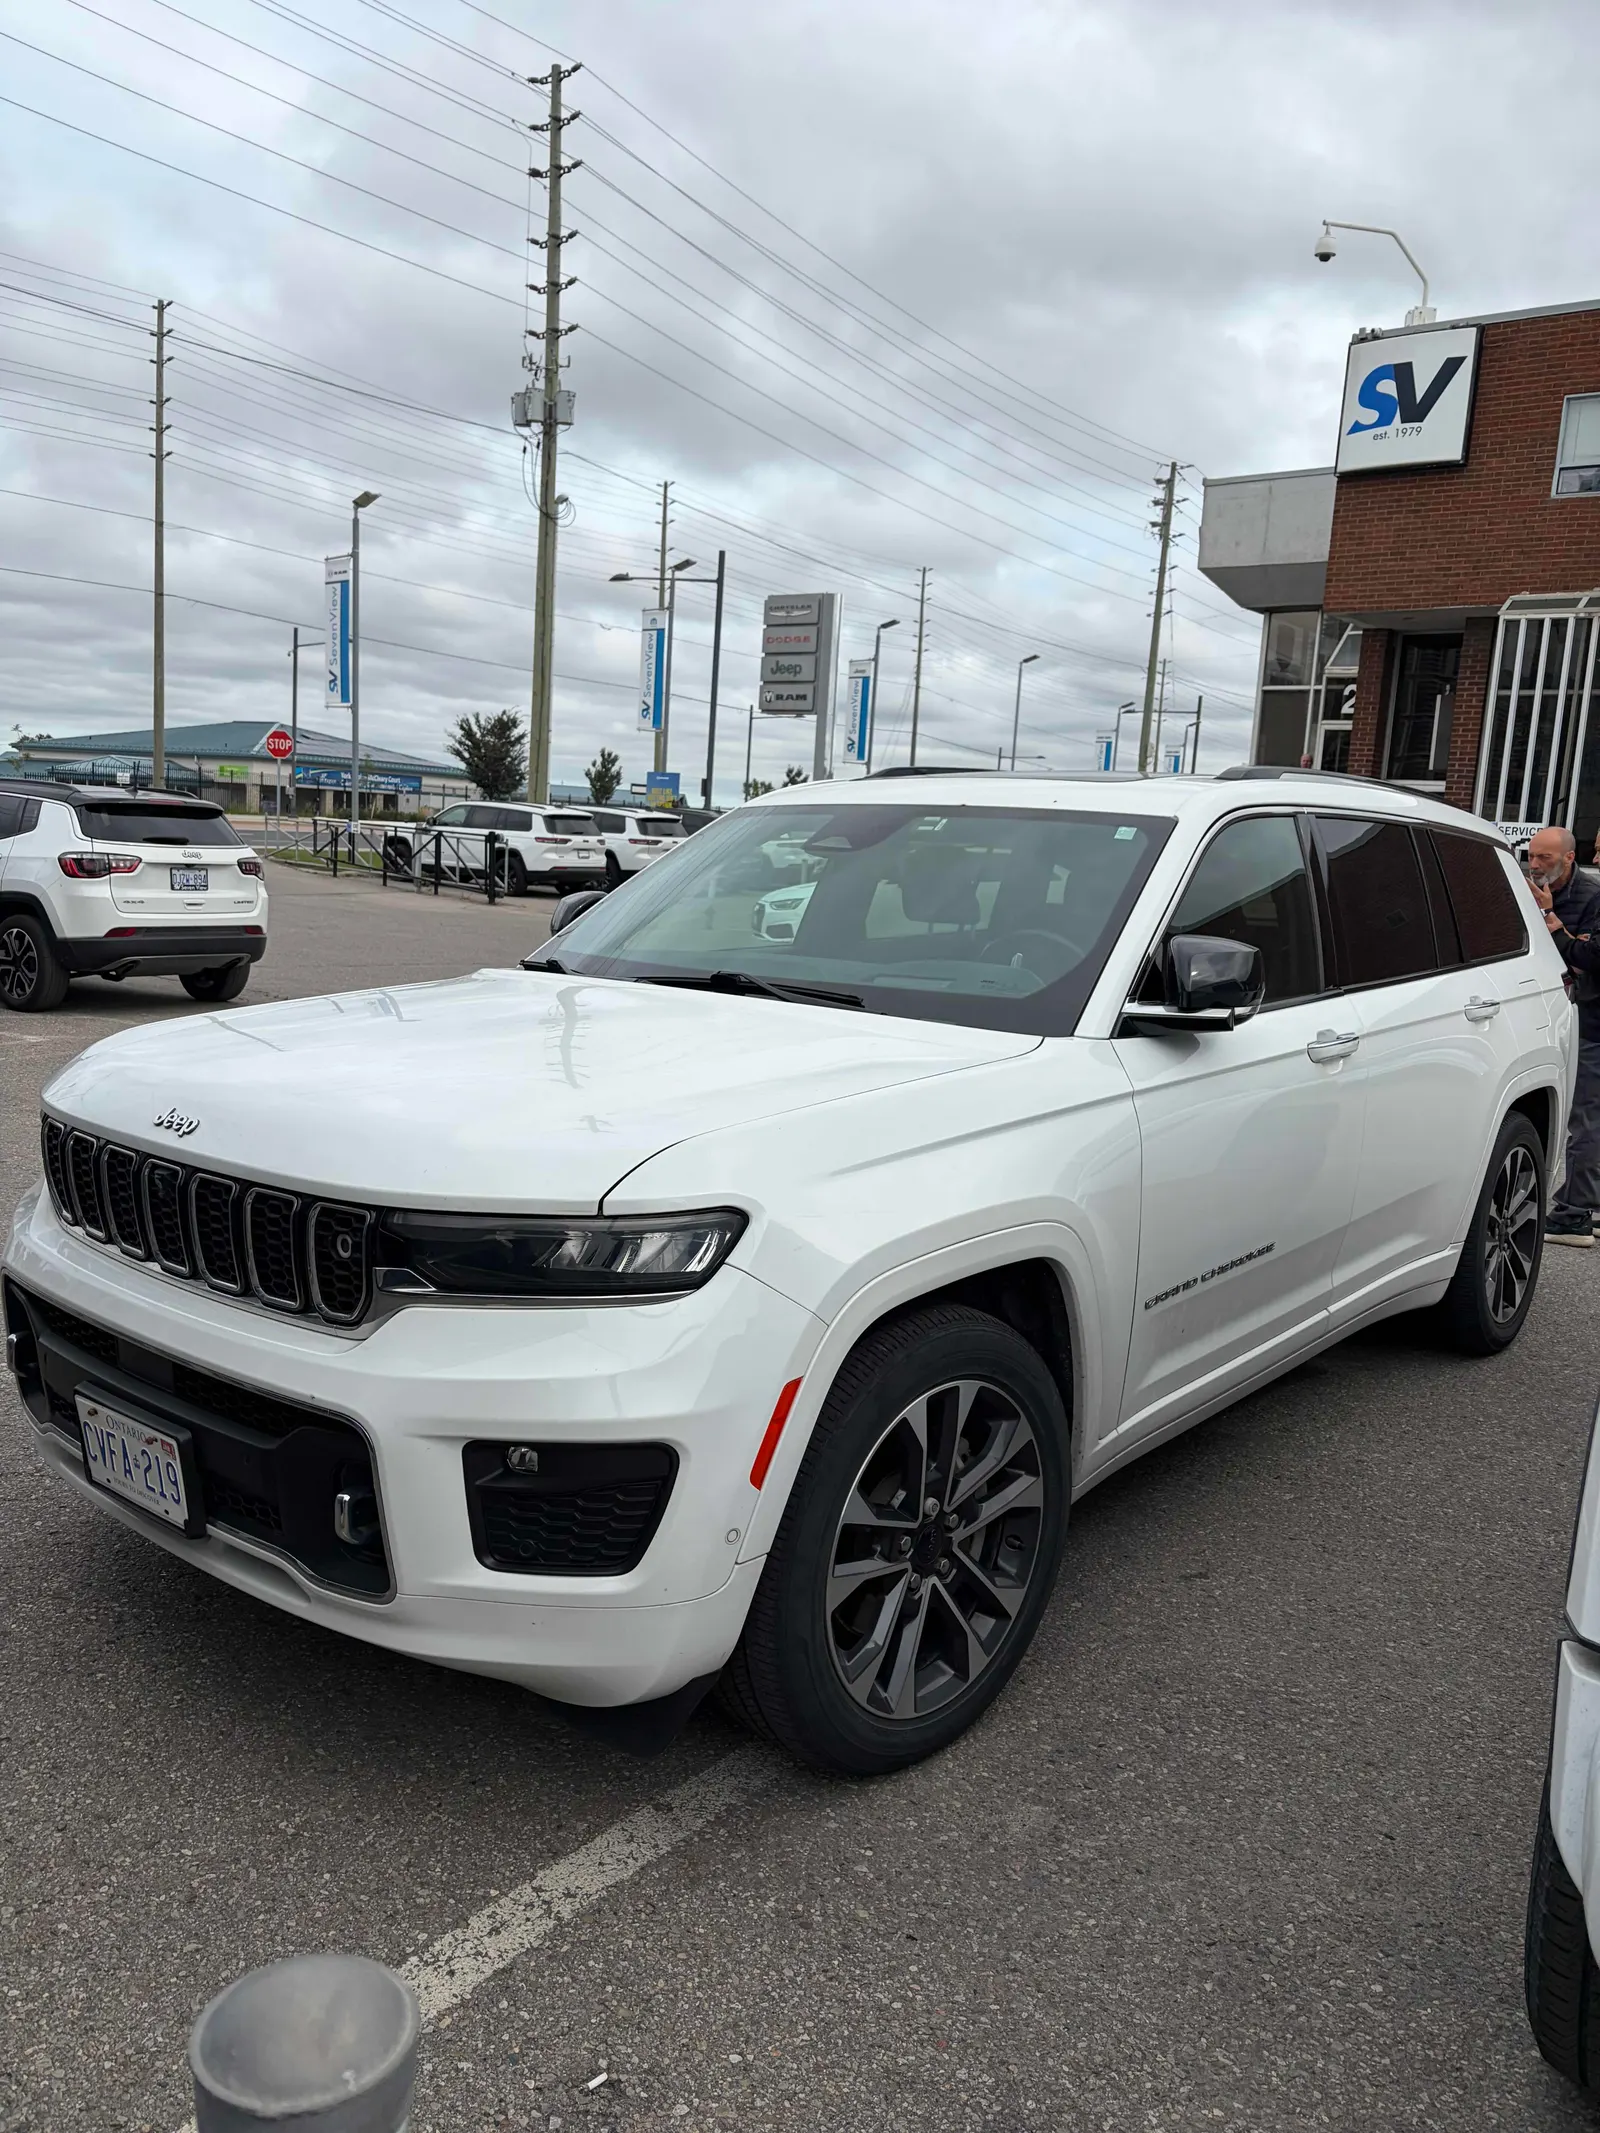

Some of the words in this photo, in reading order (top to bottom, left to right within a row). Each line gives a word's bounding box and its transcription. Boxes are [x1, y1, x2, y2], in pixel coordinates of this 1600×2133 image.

[1346, 356, 1468, 436] SV
[1373, 431, 1391, 441] est.
[1395, 426, 1423, 438] 1979
[766, 635, 811, 645] DODGE
[770, 660, 803, 678] Jeep
[775, 693, 808, 701] RAM
[1341, 684, 1357, 714] 2
[268, 738, 292, 751] STOP
[181, 850, 203, 860] Jeep
[152, 1107, 200, 1138] Jeep
[1144, 1276, 1199, 1311] GRAND
[1200, 1241, 1276, 1283] CHEROKEE
[106, 1414, 147, 1443] ONTARIO
